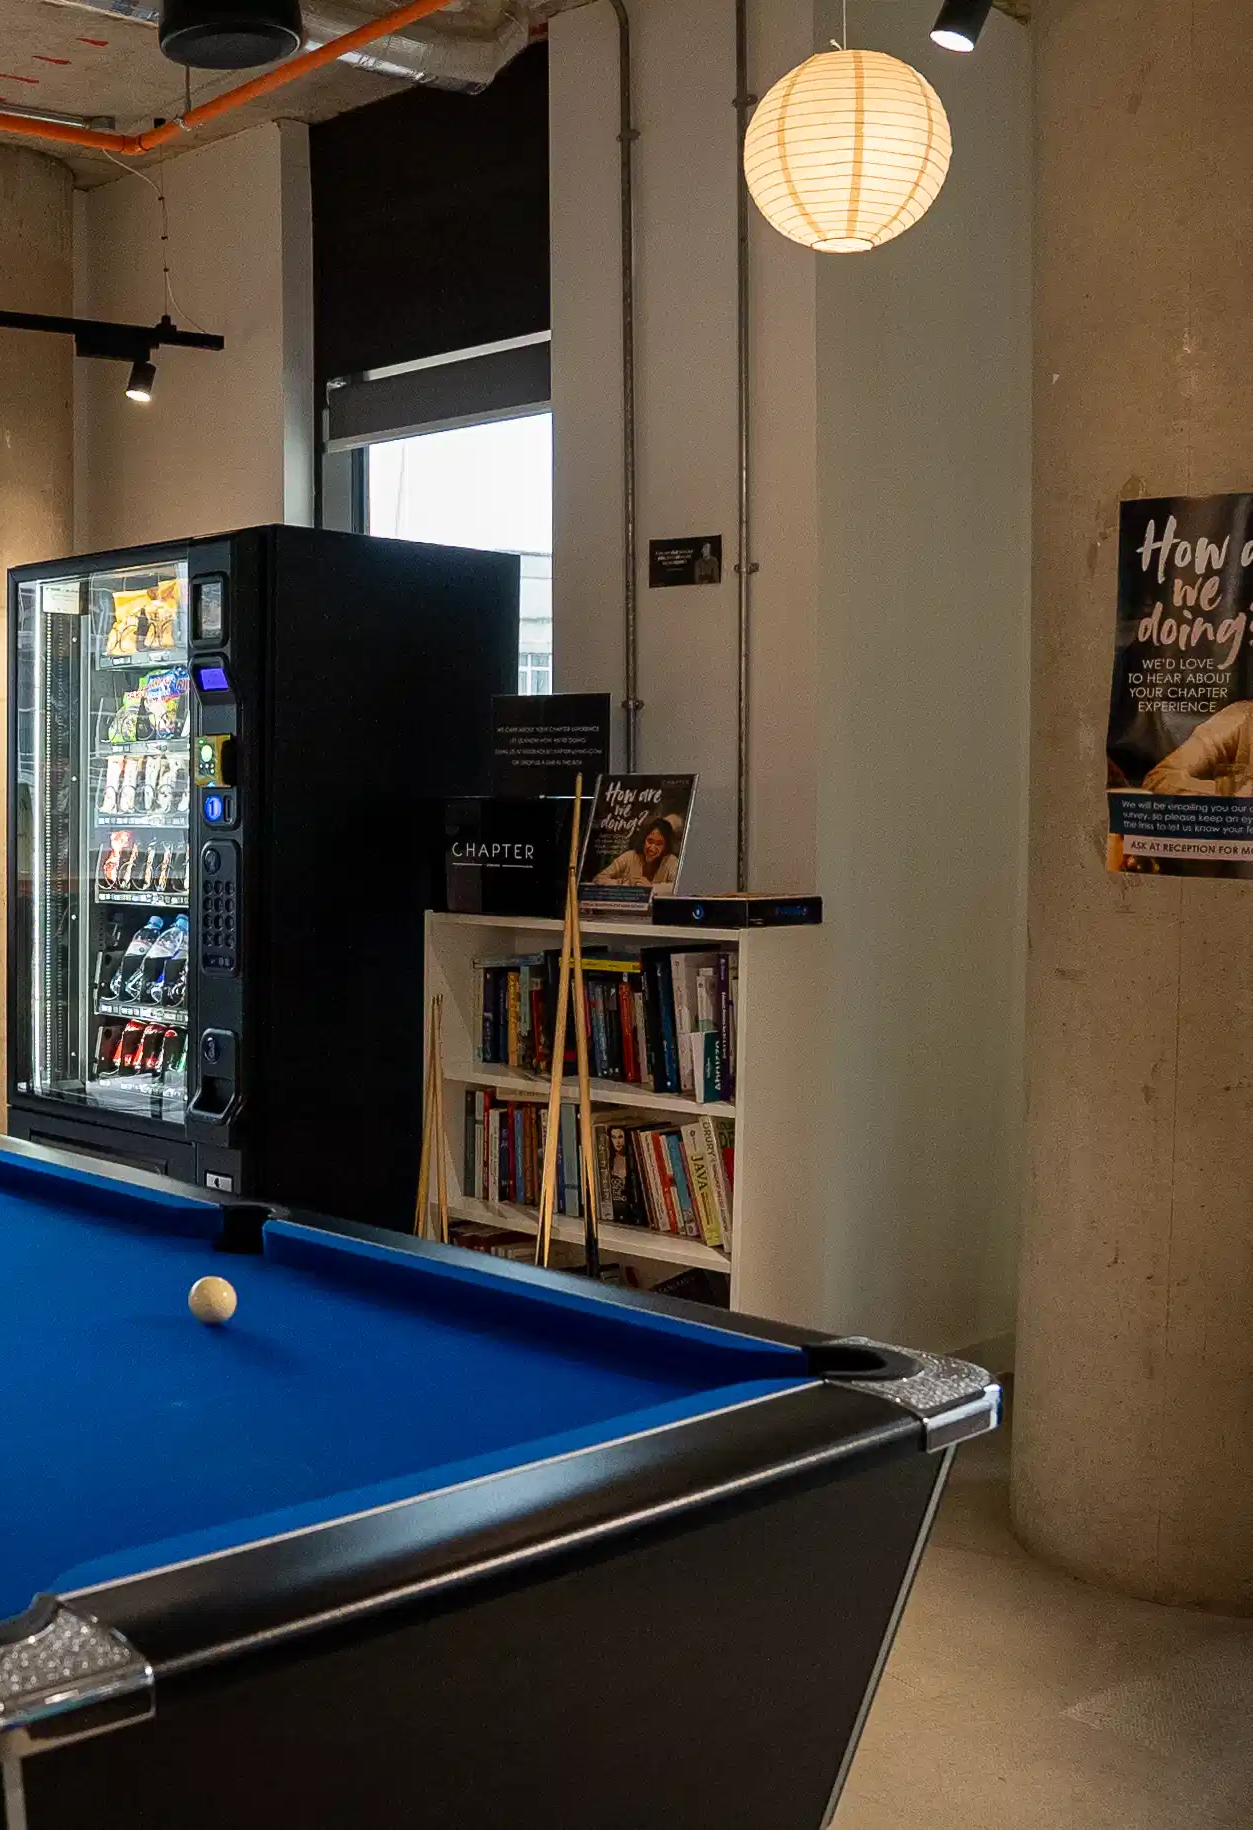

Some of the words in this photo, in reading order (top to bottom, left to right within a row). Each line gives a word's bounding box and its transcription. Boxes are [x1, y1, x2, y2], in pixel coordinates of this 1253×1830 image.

[1136, 515, 1231, 583] How
[1173, 573, 1223, 611] we
[1138, 601, 1253, 670] doing
[1142, 657, 1177, 671] WE'D
[1180, 657, 1214, 671] LOVE
[1128, 672, 1143, 685] TO
[1147, 672, 1182, 685] HEAR
[1186, 672, 1232, 685] ABOUT
[1129, 686, 1164, 700] YOUR
[1167, 686, 1228, 700] CHAPTER
[1138, 700, 1217, 714] EXPERIENCE
[605, 781, 637, 807] How
[638, 787, 663, 804] are
[614, 803, 632, 817] we
[1121, 800, 1136, 809] We
[1138, 800, 1152, 809] will
[1153, 801, 1165, 809] be
[1211, 804, 1229, 813] you
[1231, 805, 1247, 813] our
[600, 810, 649, 838] doing?
[1164, 812, 1196, 823] please
[1198, 813, 1223, 824] keep
[1225, 815, 1239, 823] an
[1241, 815, 1253, 825] ey
[1123, 820, 1137, 829] the
[1156, 822, 1167, 831] to
[1168, 822, 1180, 832] let
[1194, 824, 1220, 833] know
[1222, 825, 1244, 835] your
[452, 842, 535, 860] CHAPTER
[1130, 840, 1147, 850] ASK
[1149, 841, 1161, 851] AT
[1163, 843, 1216, 854] RECEPTION
[1218, 845, 1239, 855] FOR
[702, 1122, 716, 1157] DRURY
[691, 1155, 708, 1191] JAVA
